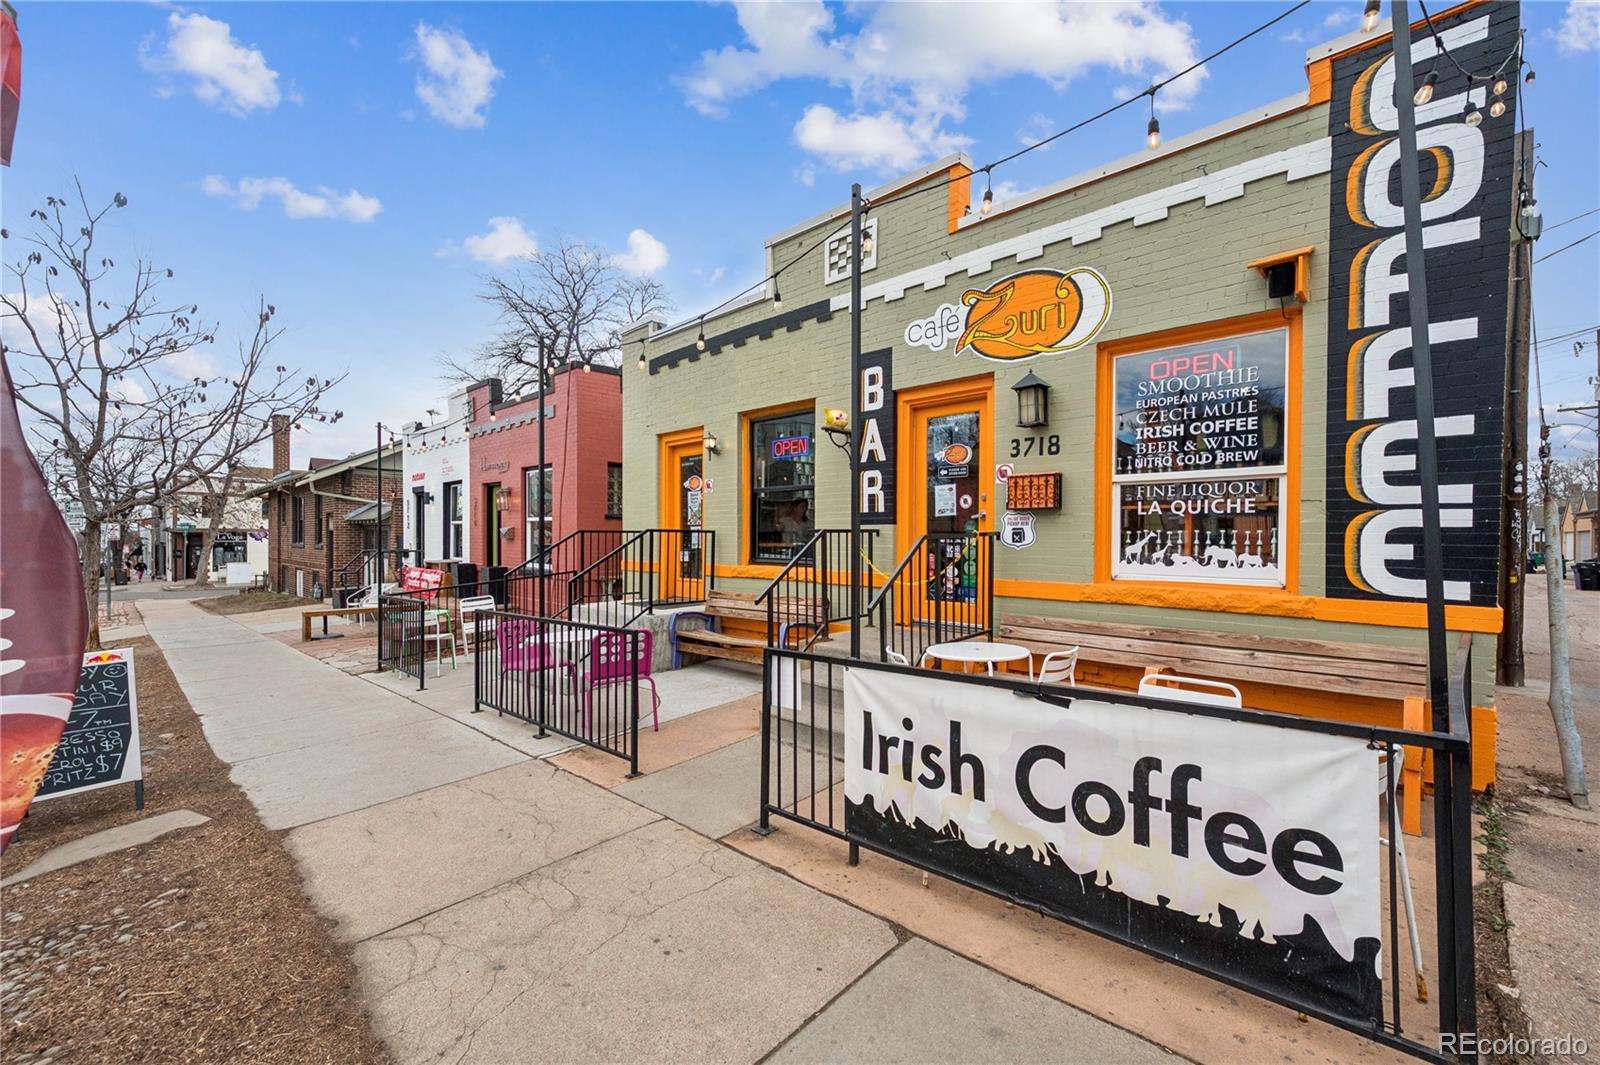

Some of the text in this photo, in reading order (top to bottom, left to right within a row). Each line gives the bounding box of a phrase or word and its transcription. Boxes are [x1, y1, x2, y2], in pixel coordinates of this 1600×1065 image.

[907, 281, 1067, 354] café Zuri
[1346, 15, 1490, 602] COFFEE
[1150, 350, 1234, 380] OPEN
[1137, 366, 1260, 397] SMOOTHIE
[1136, 385, 1259, 409] EUROPEAN PASTRIES
[1136, 399, 1258, 424] CZECH MULE
[860, 366, 887, 513] BAR
[1135, 416, 1259, 440] IRISH COFFEE
[774, 438, 808, 457] OPEN
[1009, 434, 1061, 458] 3718
[1136, 433, 1258, 455] BEER & WINE
[1134, 449, 1259, 469] NITRO COLD BREW
[1137, 480, 1259, 498] FINE LIQUOR
[1137, 497, 1256, 517] LA QUICHE
[76, 680, 117, 693] UR
[100, 737, 123, 752] $9
[95, 753, 123, 773] $7
[862, 710, 1345, 896] Irish Coffee
